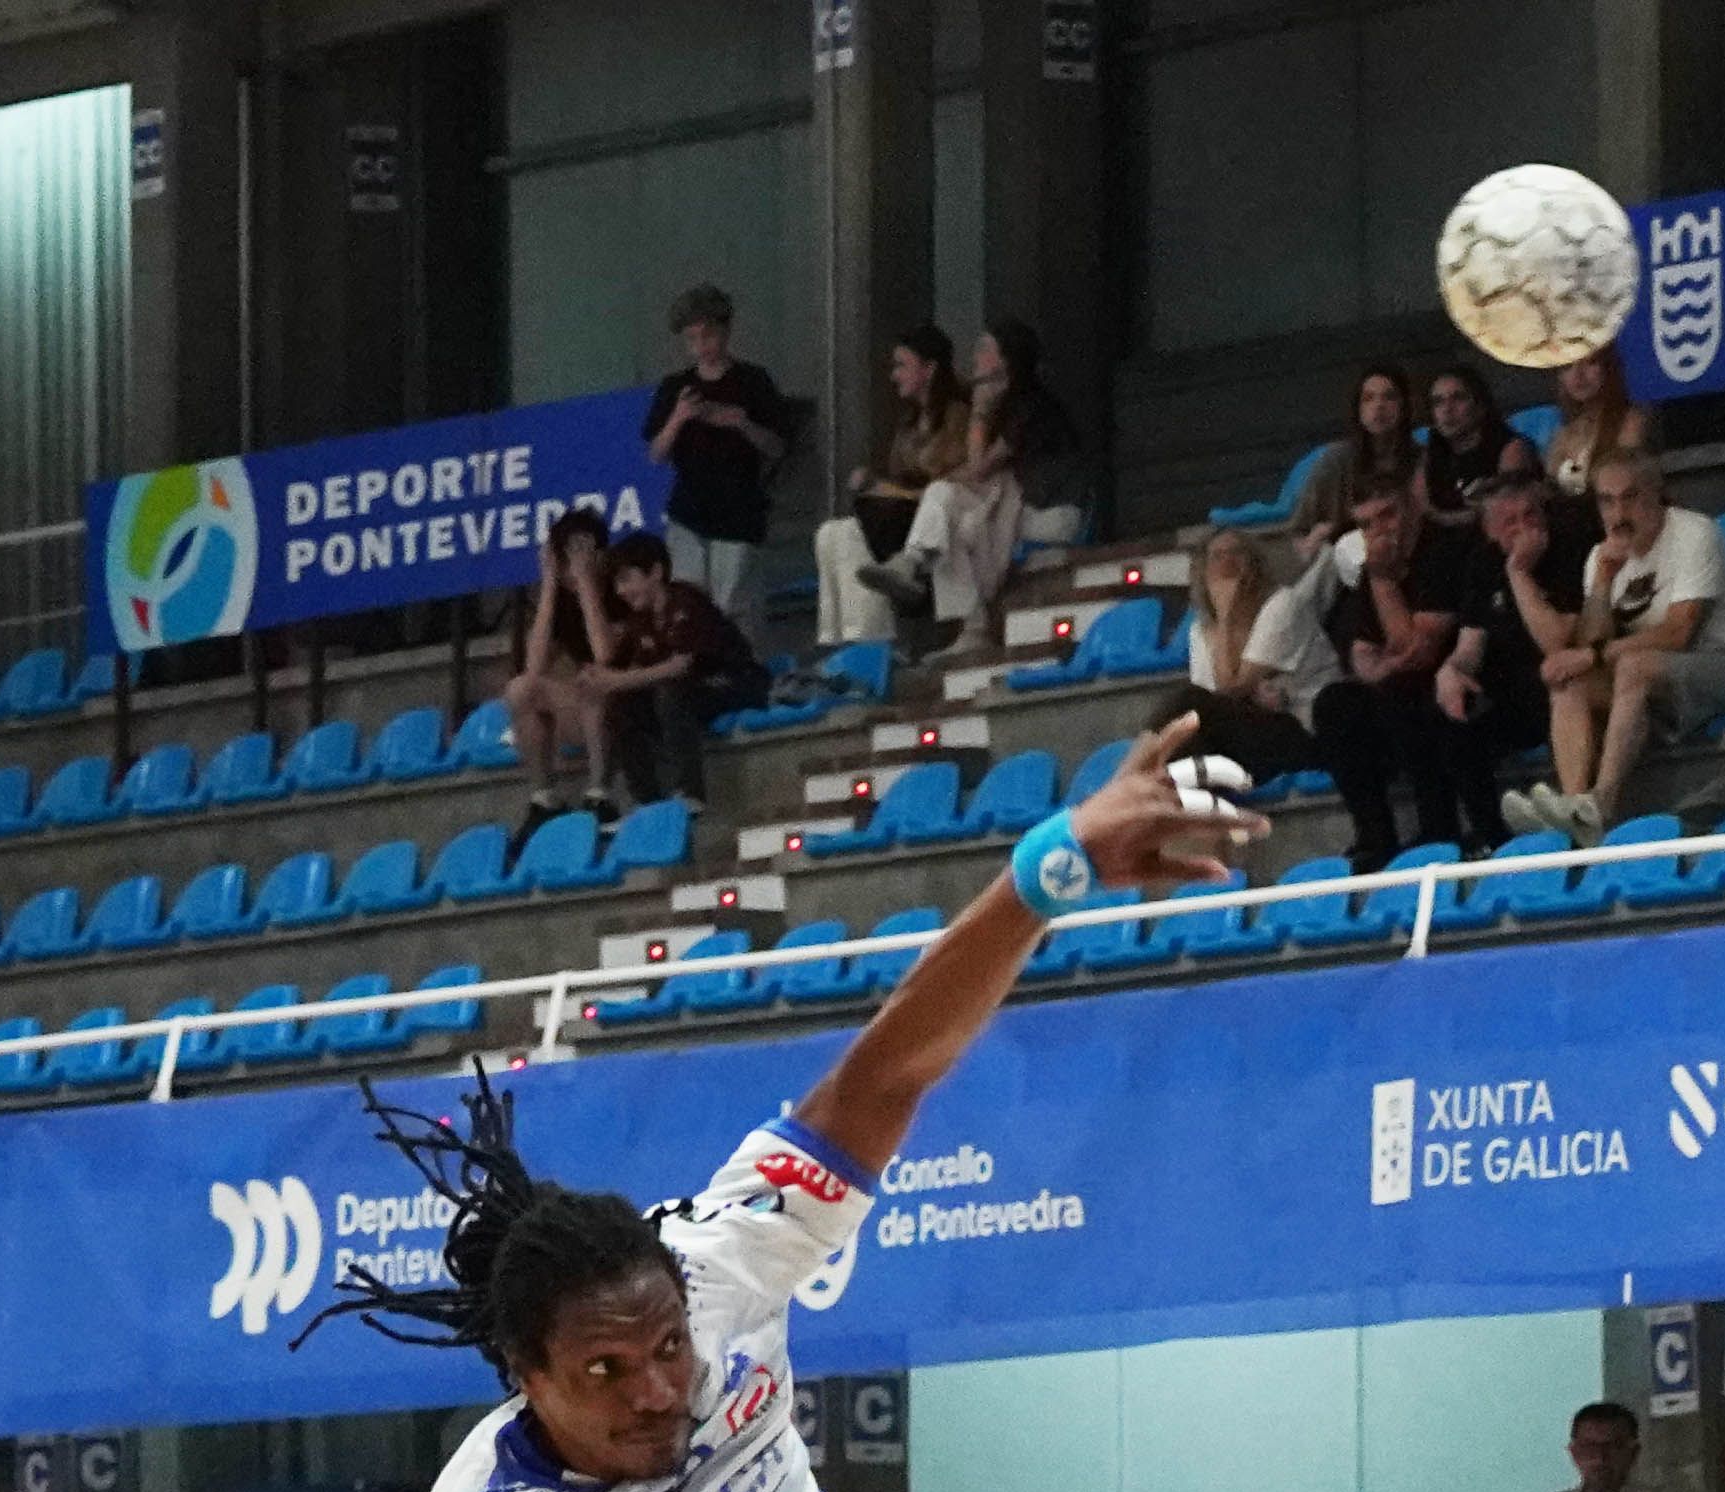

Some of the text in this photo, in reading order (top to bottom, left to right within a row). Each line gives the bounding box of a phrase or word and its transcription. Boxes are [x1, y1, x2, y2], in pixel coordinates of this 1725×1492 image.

[286, 445, 534, 527] DEPORTE
[1427, 1080, 1554, 1132] XUNTA
[880, 1143, 994, 1196] Concello
[1422, 1130, 1629, 1188] DE GALICIA
[877, 1188, 1085, 1248] de Pontevedra
[1655, 1330, 1690, 1385] C
